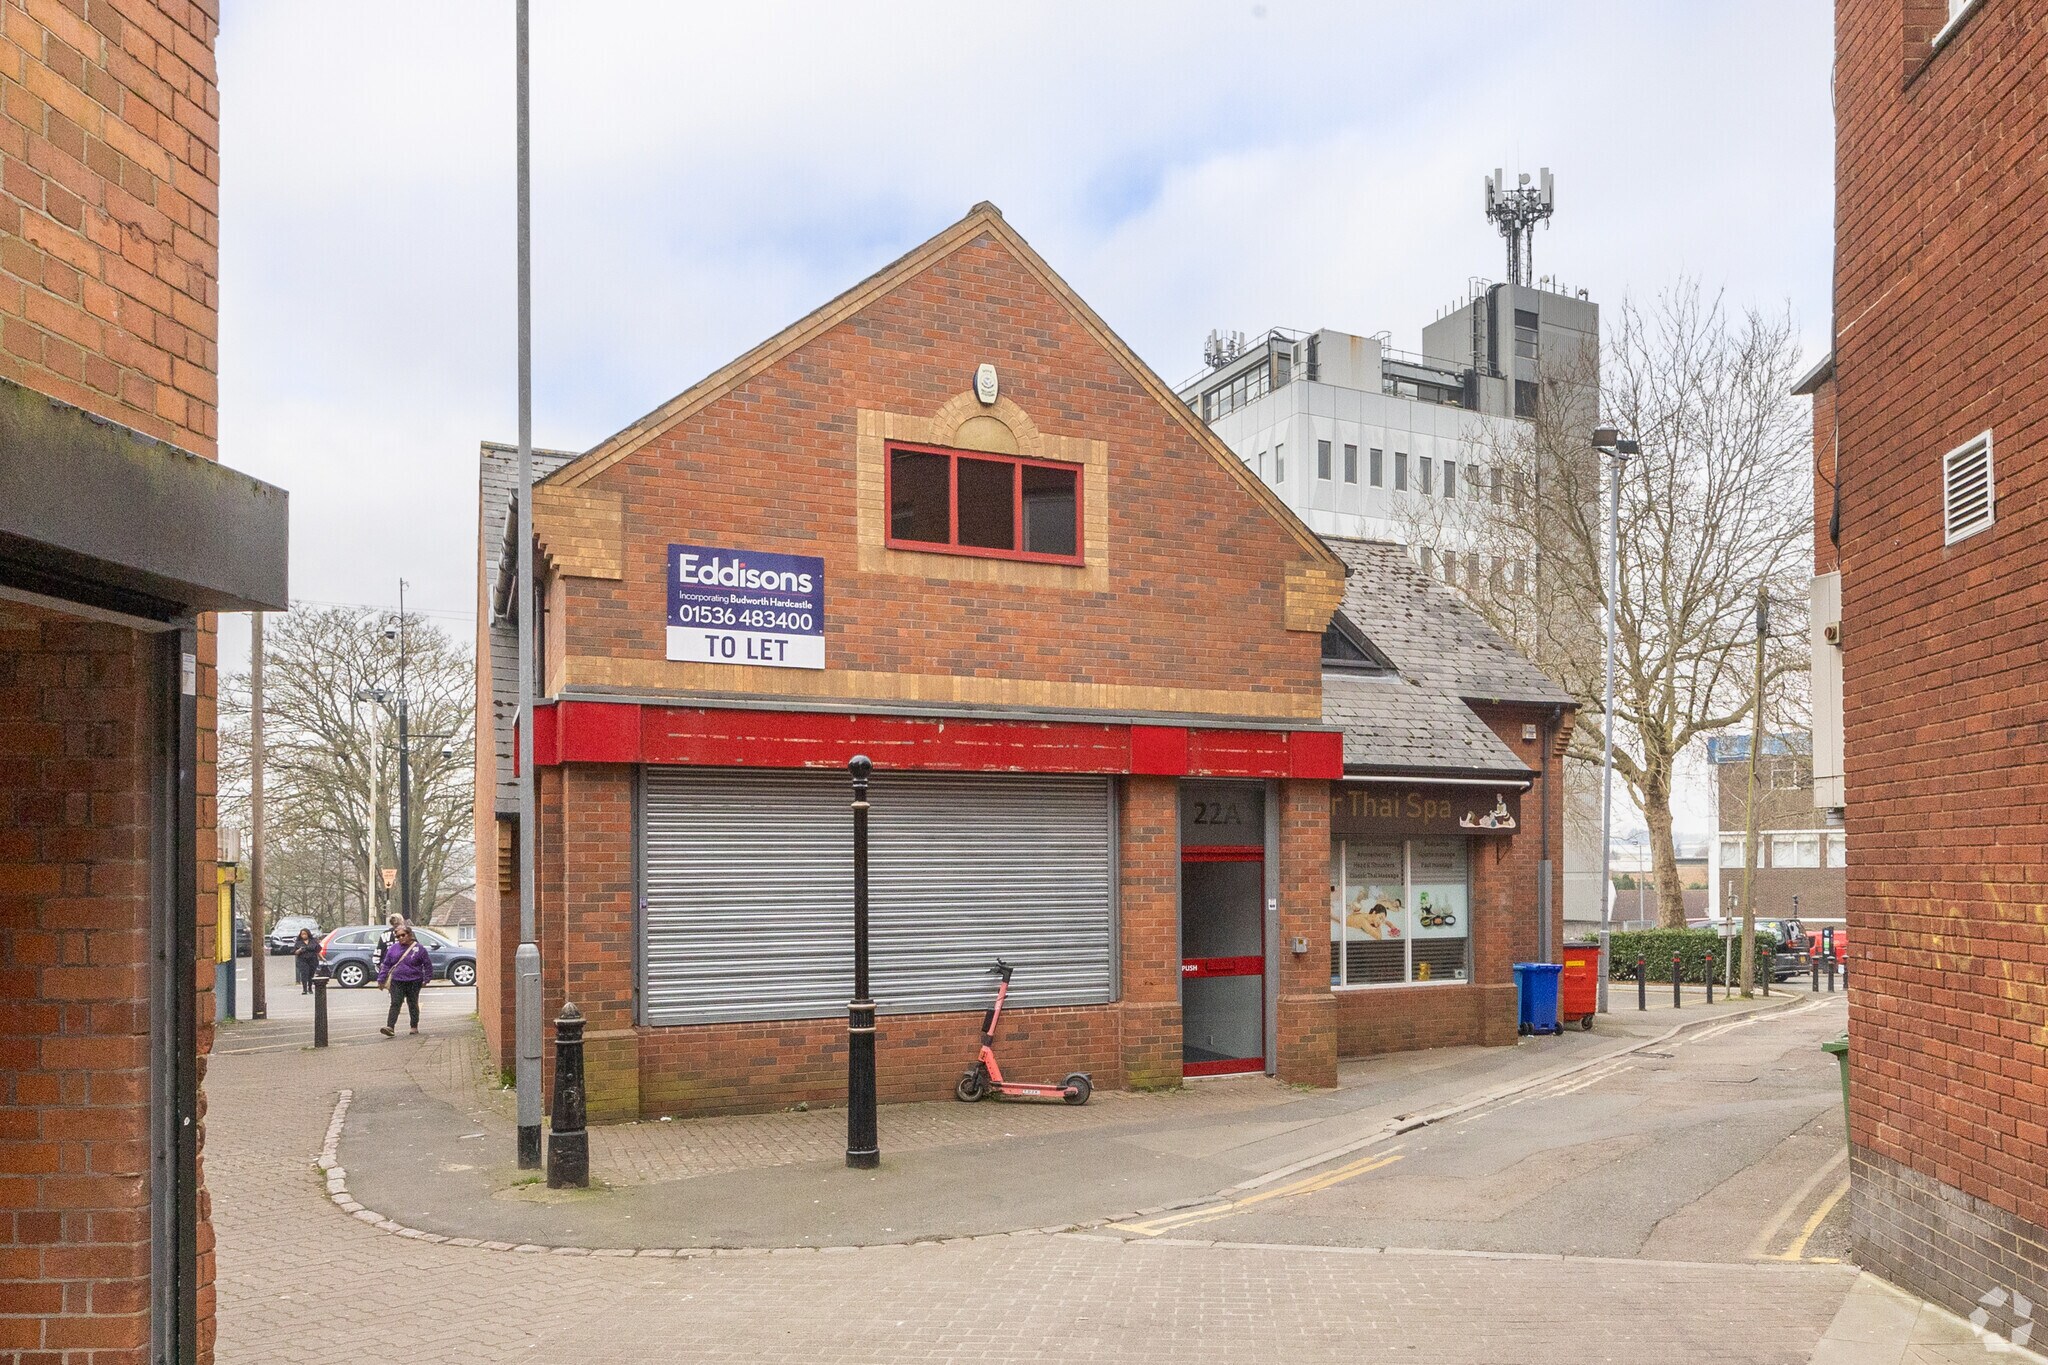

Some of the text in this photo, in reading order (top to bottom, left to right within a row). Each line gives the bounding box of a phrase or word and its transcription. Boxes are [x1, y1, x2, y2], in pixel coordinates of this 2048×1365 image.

[679, 553, 813, 593] Eddisons
[680, 590, 813, 609] Incorporating Budworth Hardcastle
[680, 604, 813, 630] 01536 483400
[704, 634, 789, 661] TO LET
[1193, 801, 1241, 825] 22A
[1347, 790, 1399, 817] Thai
[1406, 792, 1452, 826] Spa
